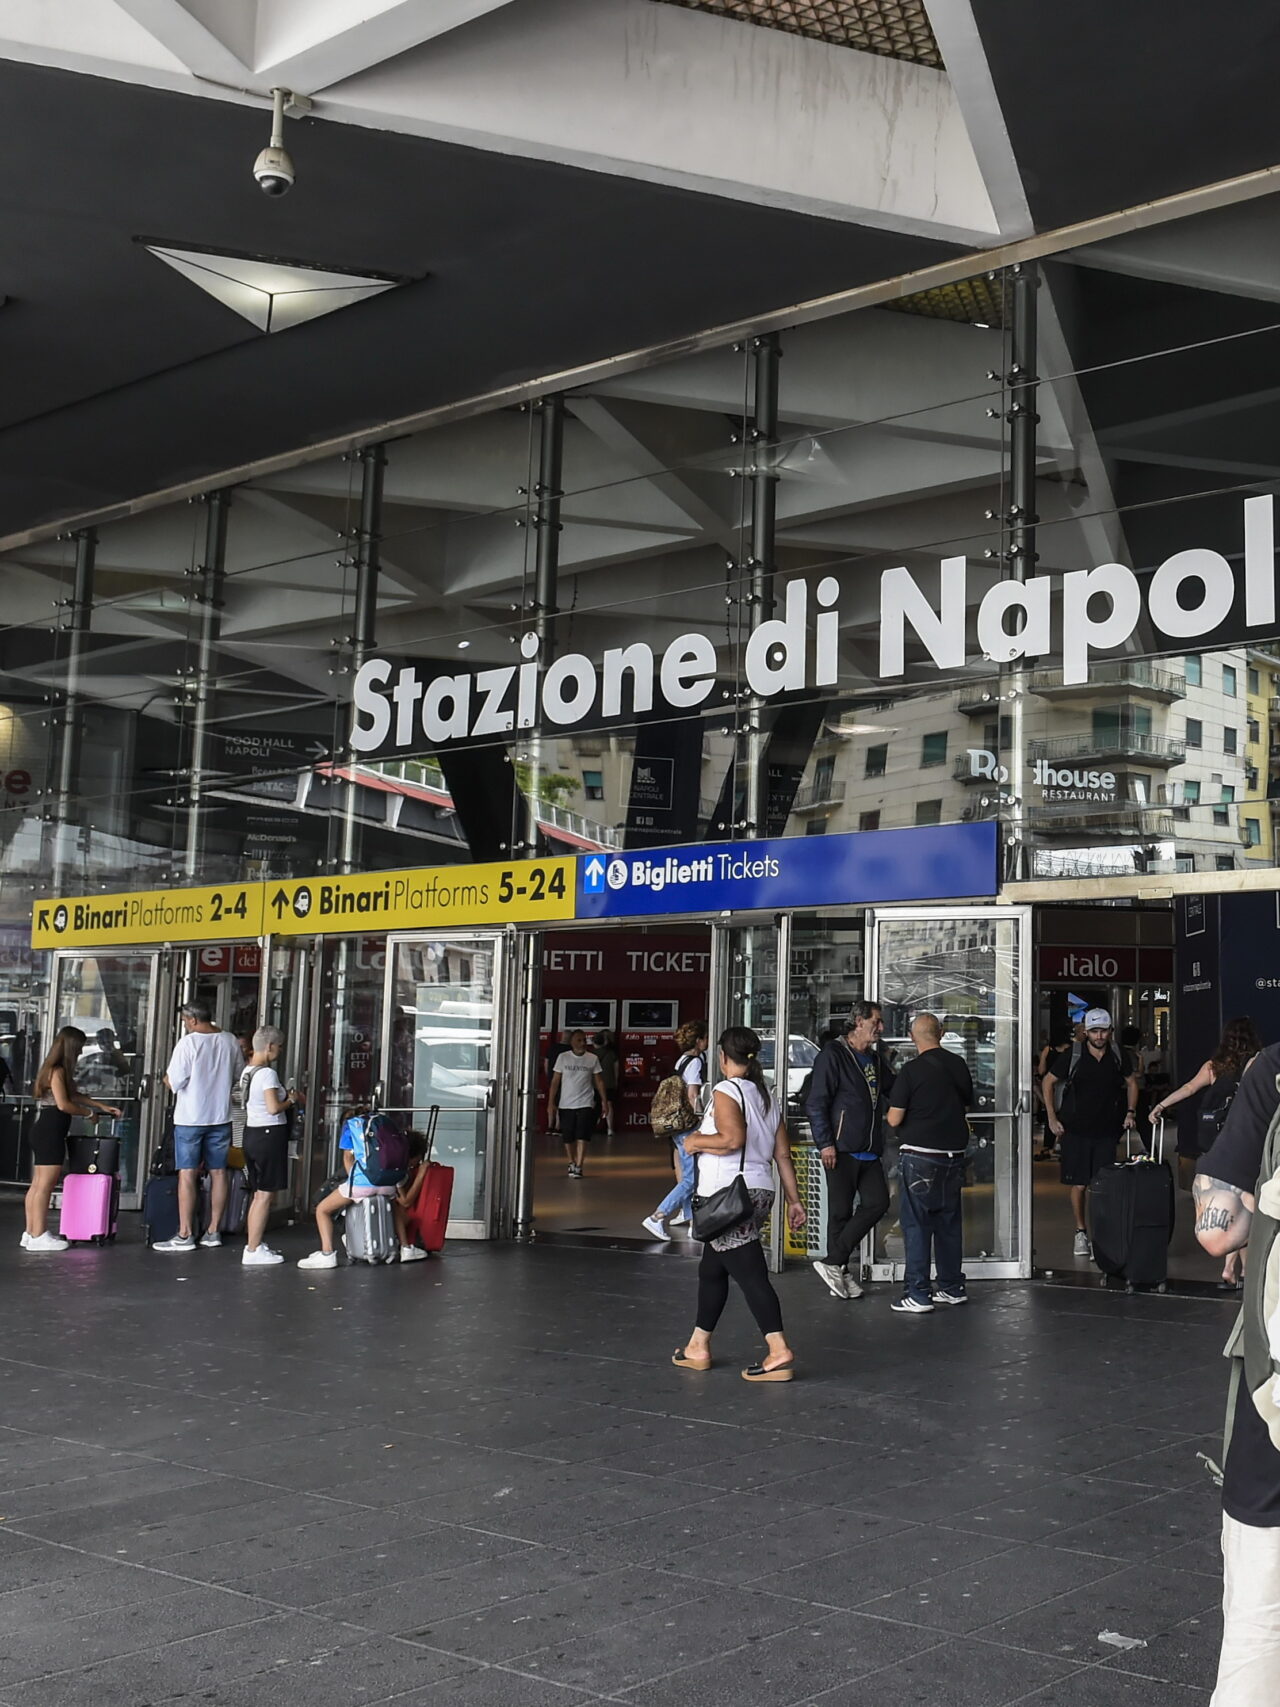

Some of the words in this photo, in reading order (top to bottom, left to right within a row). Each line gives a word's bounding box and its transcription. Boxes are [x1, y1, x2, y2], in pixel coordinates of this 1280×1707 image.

[349, 631, 717, 752] Stazione
[745, 576, 840, 696] di
[225, 736, 261, 747] FOOD
[263, 737, 295, 749] HALL
[225, 746, 270, 758] NAPOLI
[966, 749, 1116, 790] Rodhouse
[1042, 789, 1116, 802] RESTAURANT
[319, 880, 391, 915] Binari
[393, 876, 489, 910] Platforms
[498, 867, 567, 904] 5-24
[631, 856, 714, 891] Biglietti
[717, 851, 780, 880] Tickets
[73, 900, 128, 931] Binari
[130, 896, 203, 927] Platforms
[210, 891, 247, 922] 2-4
